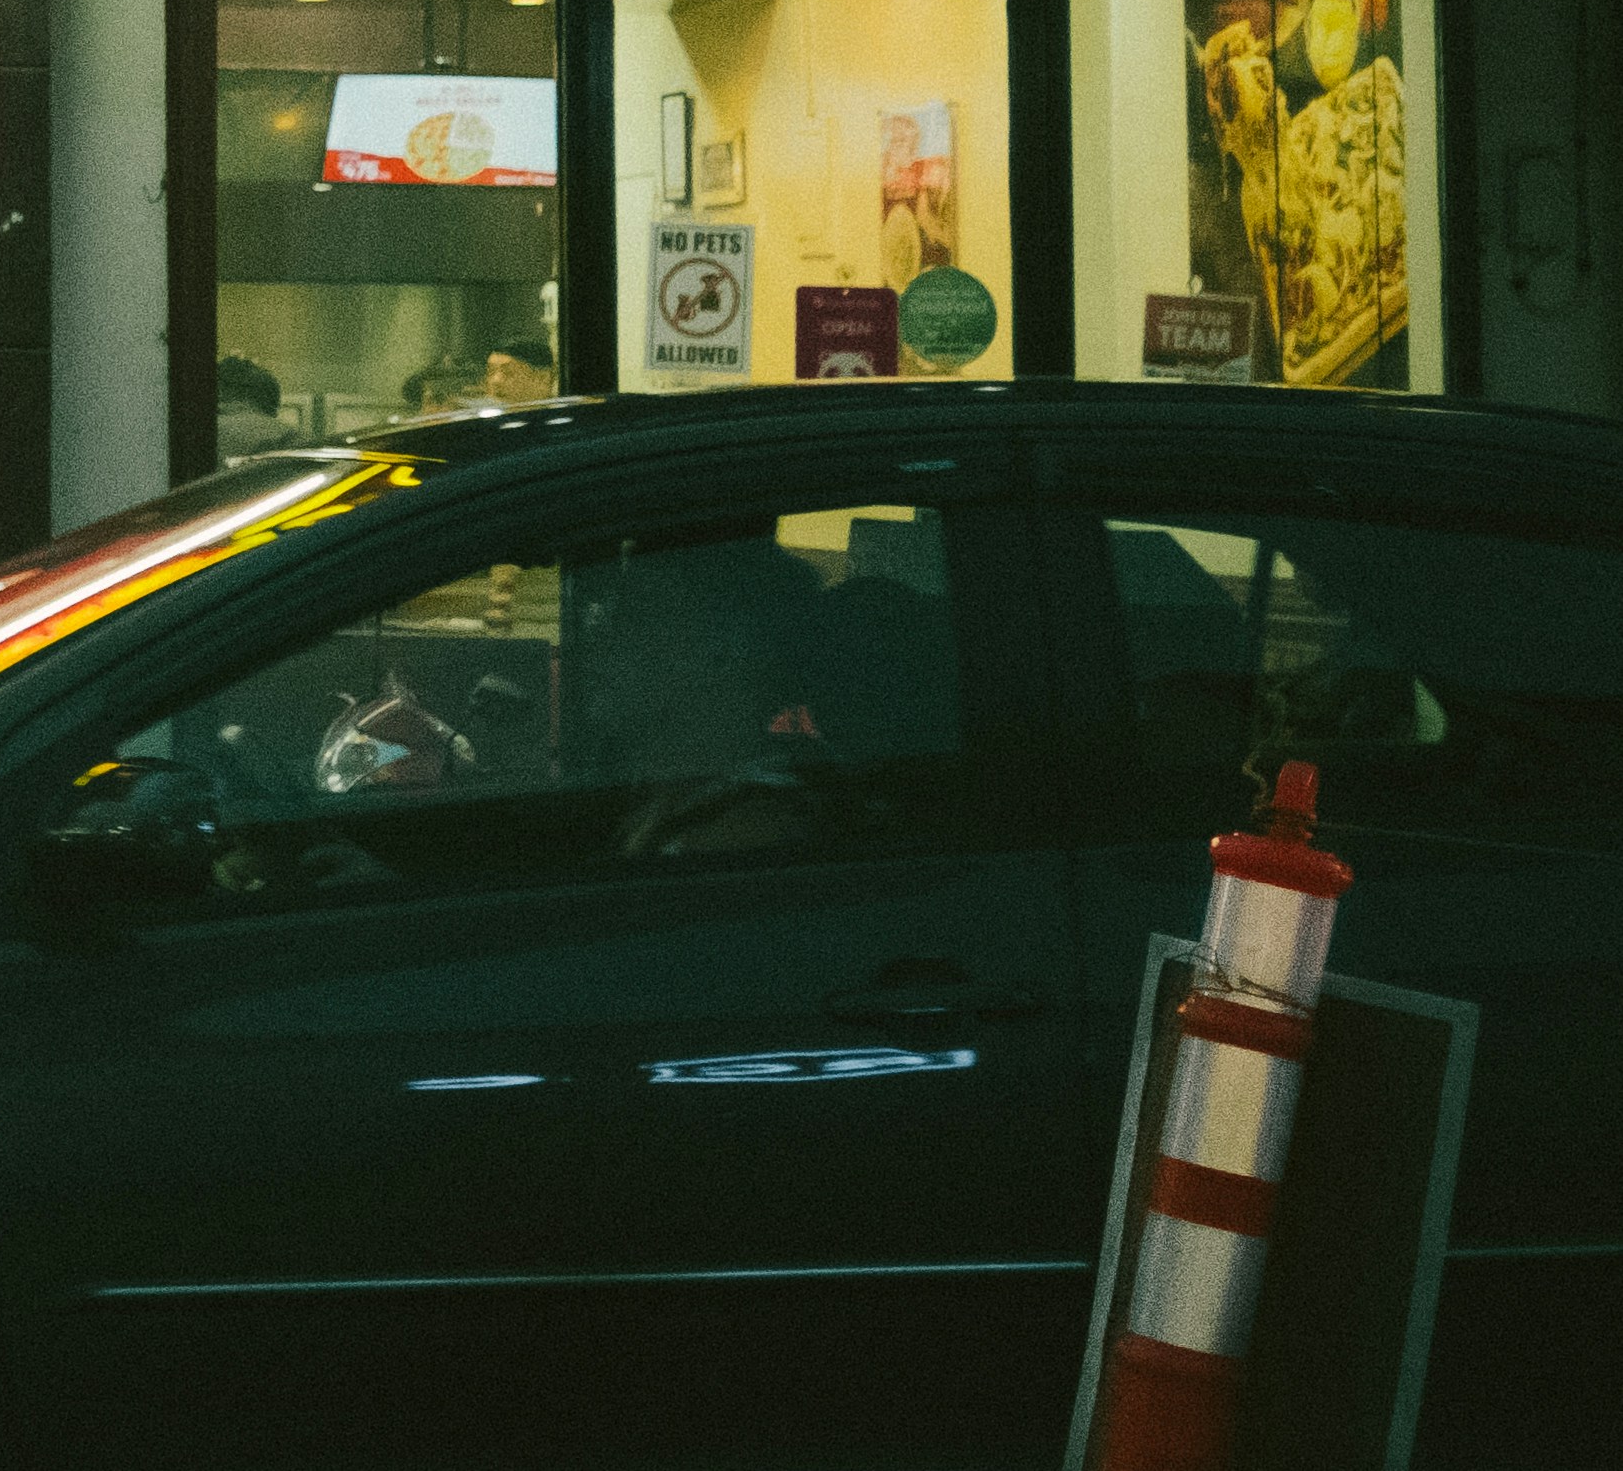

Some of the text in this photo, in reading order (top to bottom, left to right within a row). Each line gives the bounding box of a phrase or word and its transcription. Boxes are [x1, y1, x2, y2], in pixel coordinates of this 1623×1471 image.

[661, 231, 742, 254] NO PETS
[1158, 325, 1232, 352] TEAM
[656, 344, 738, 365] ALLOWED
